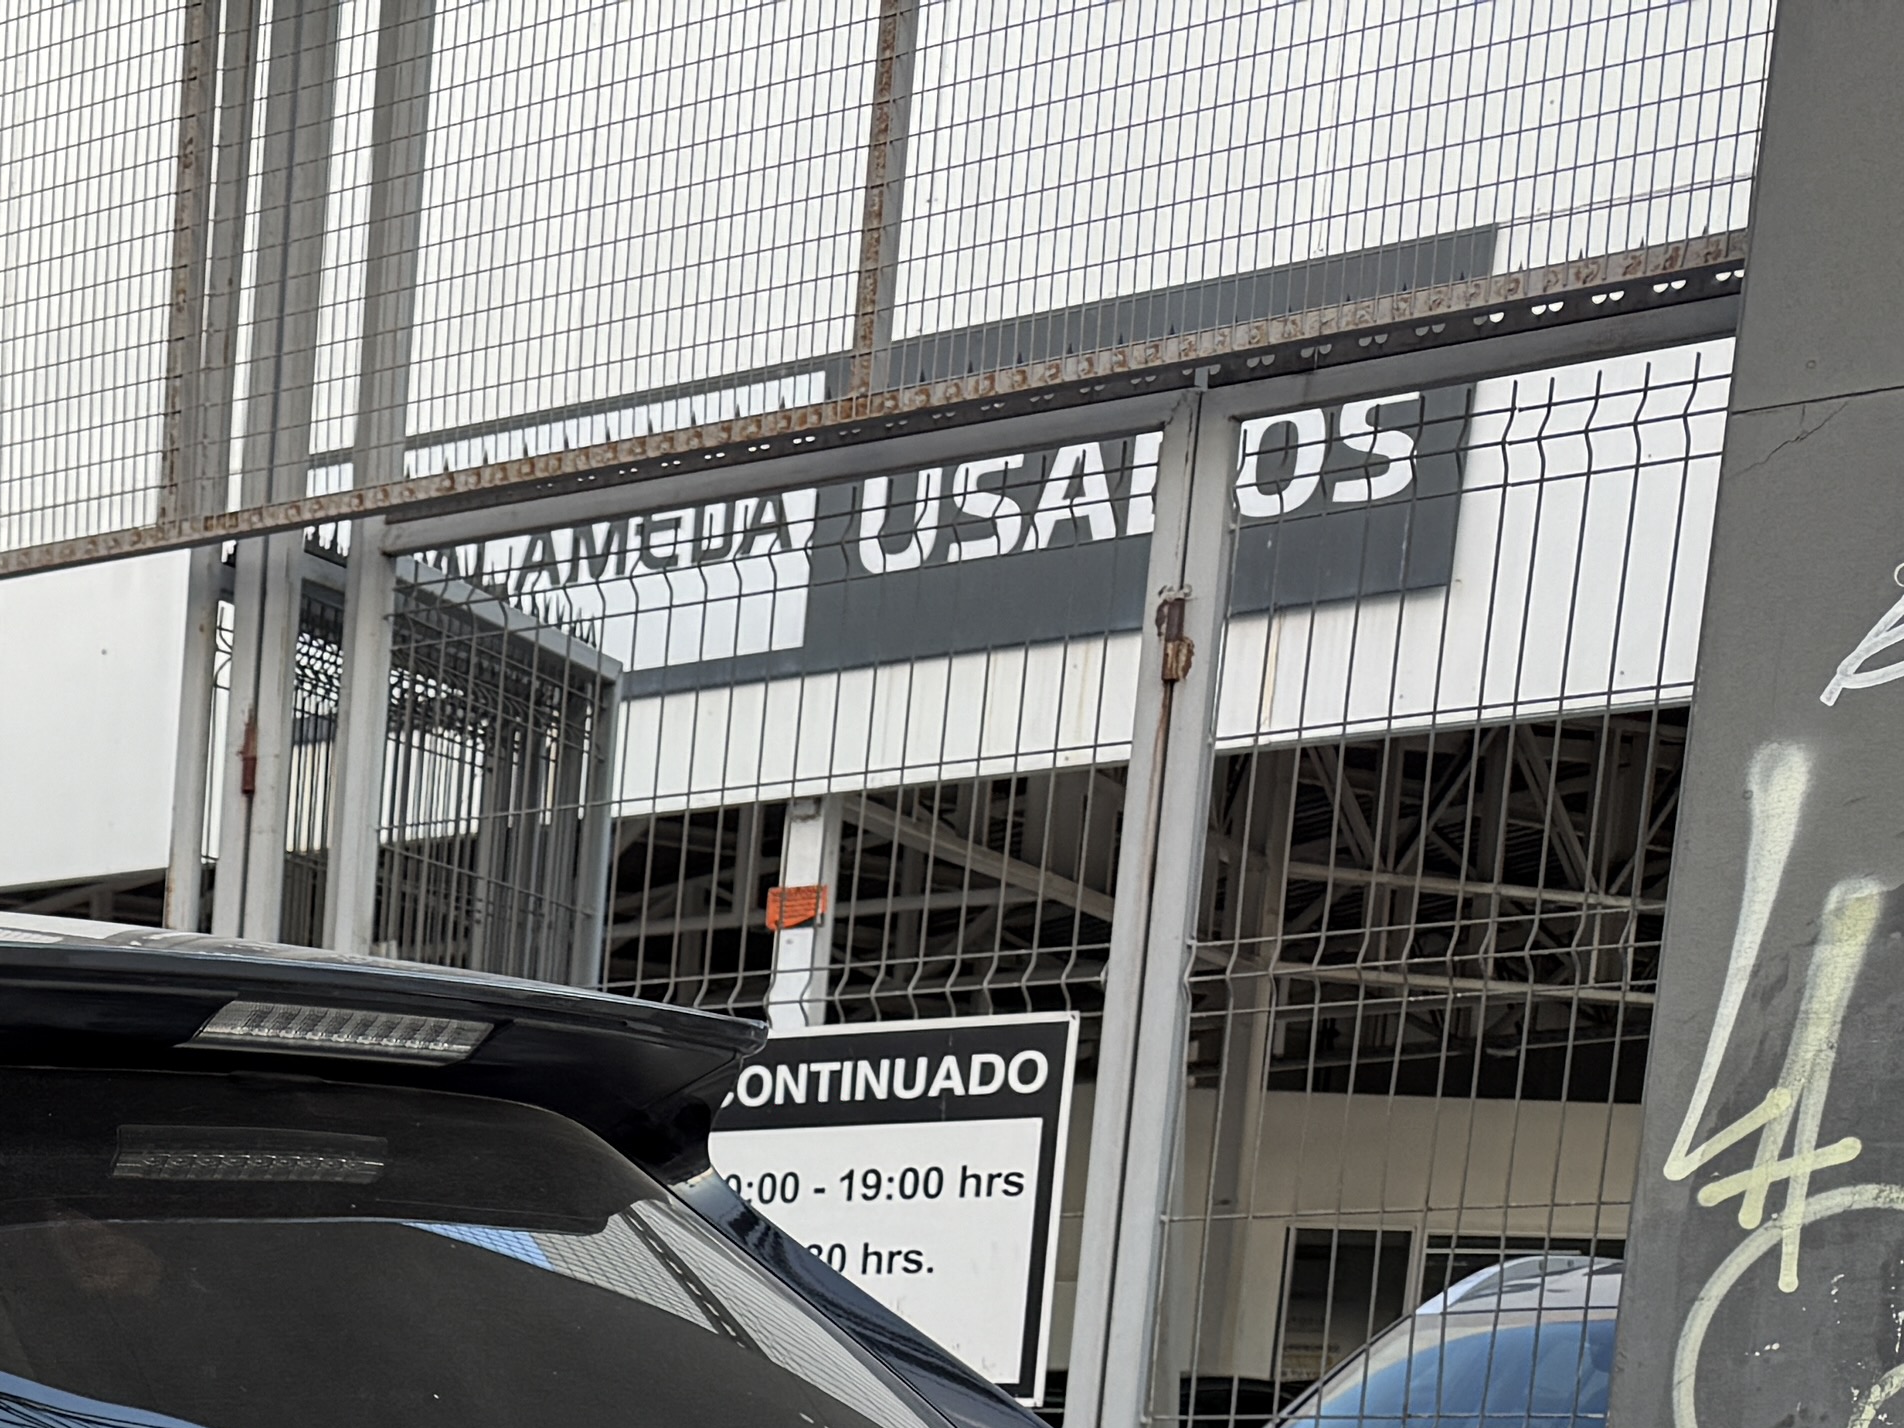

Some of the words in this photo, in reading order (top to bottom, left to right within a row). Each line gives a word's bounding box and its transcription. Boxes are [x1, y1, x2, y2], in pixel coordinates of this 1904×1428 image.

[721, 1049, 1049, 1108] ONTINUADO
[839, 1166, 945, 1202] 19:00
[959, 1165, 1026, 1199] hrs
[861, 1243, 935, 1276] hrs.
